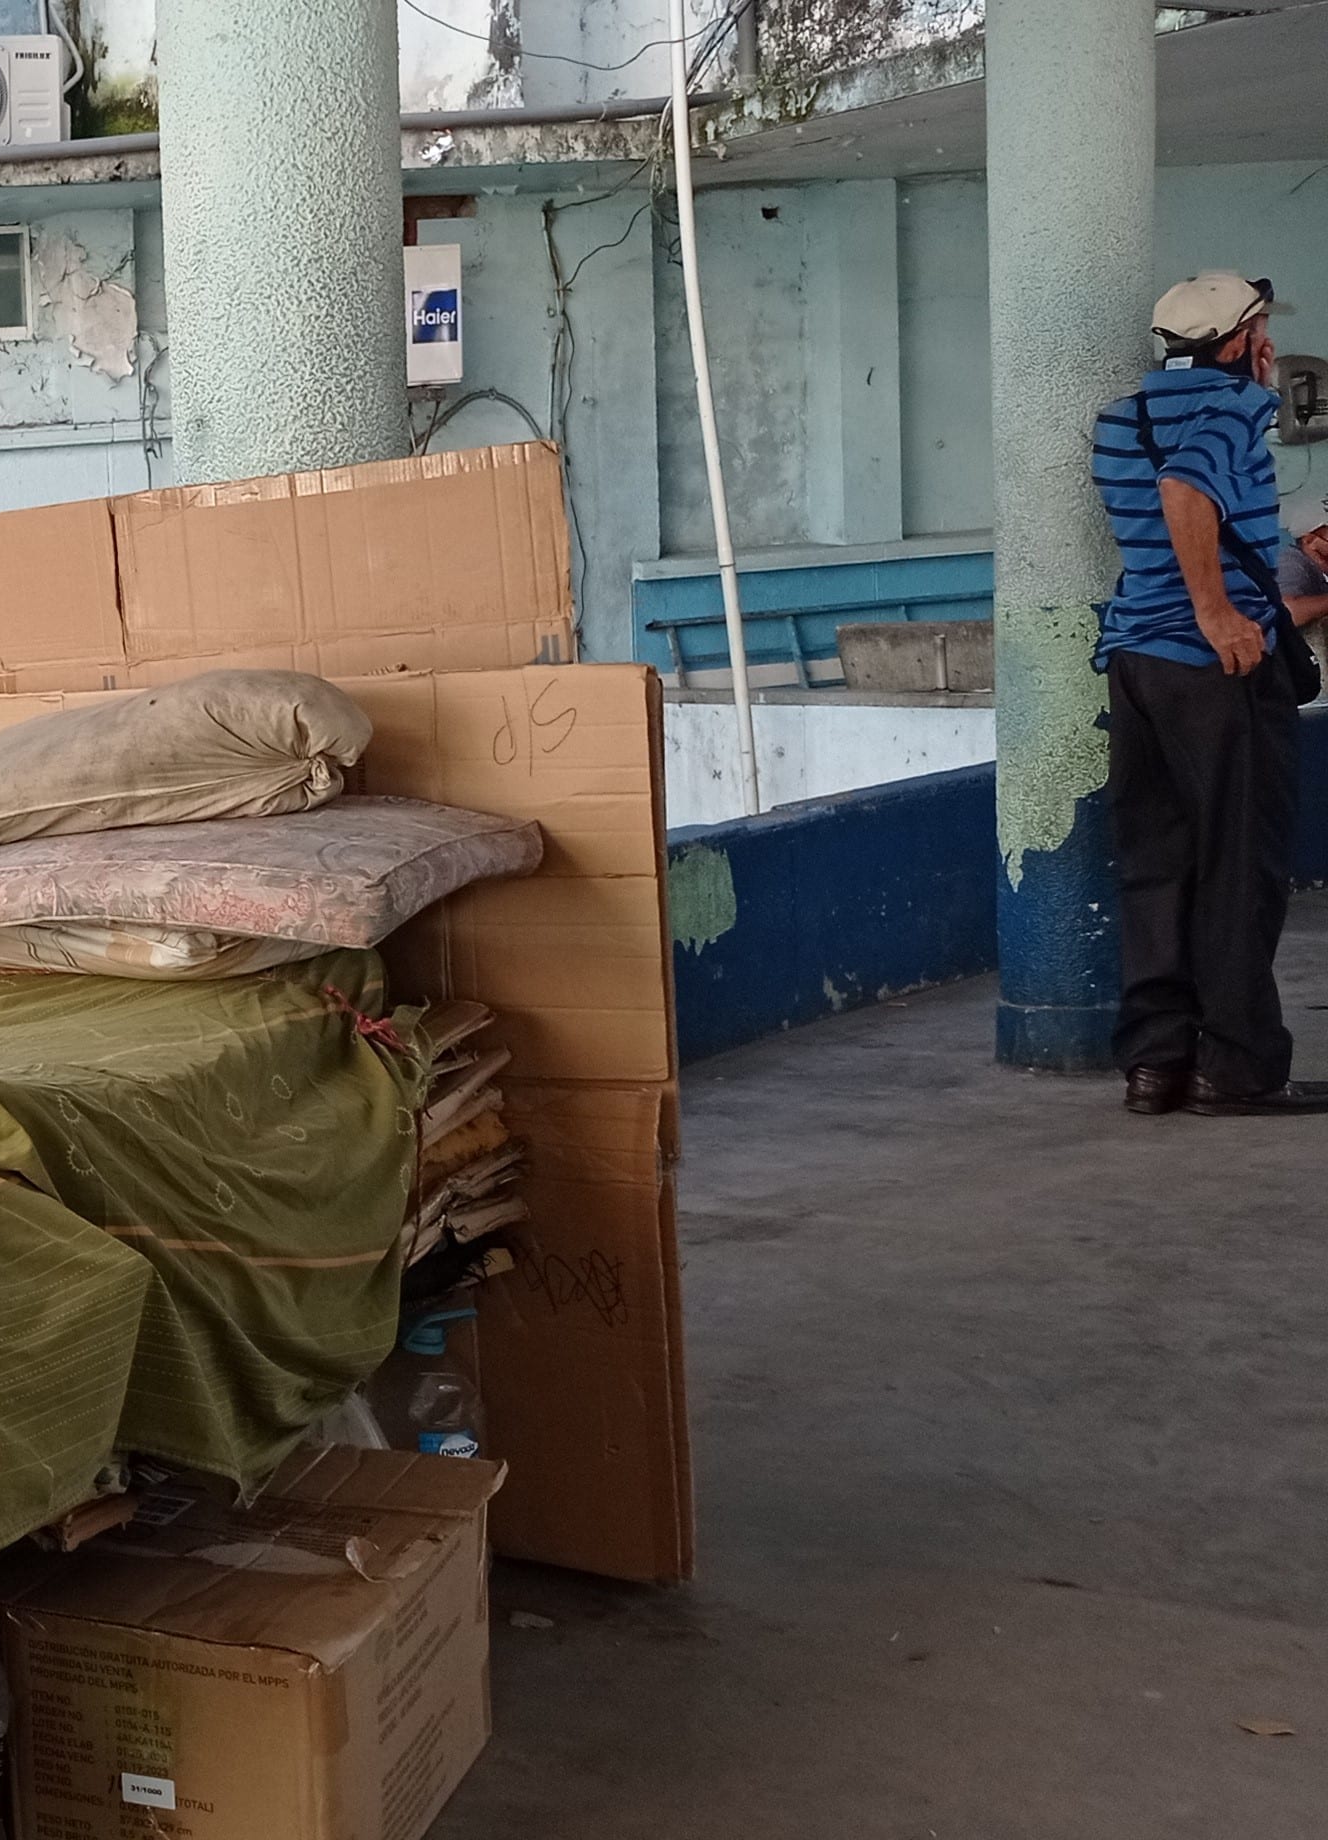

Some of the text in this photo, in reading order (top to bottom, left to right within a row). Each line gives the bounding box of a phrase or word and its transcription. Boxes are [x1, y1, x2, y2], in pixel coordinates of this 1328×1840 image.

[413, 308, 457, 326] Haier
[84, 1662, 98, 1673] SU
[99, 1665, 133, 1679] VENTA
[99, 1650, 149, 1667] GRATUITA
[150, 1658, 216, 1679] AUTORIZADA
[218, 1669, 240, 1683] POR
[241, 1672, 256, 1685] EL
[258, 1675, 289, 1688] MPPS
[87, 1676, 107, 1688] DEL
[109, 1680, 138, 1694] MPPS
